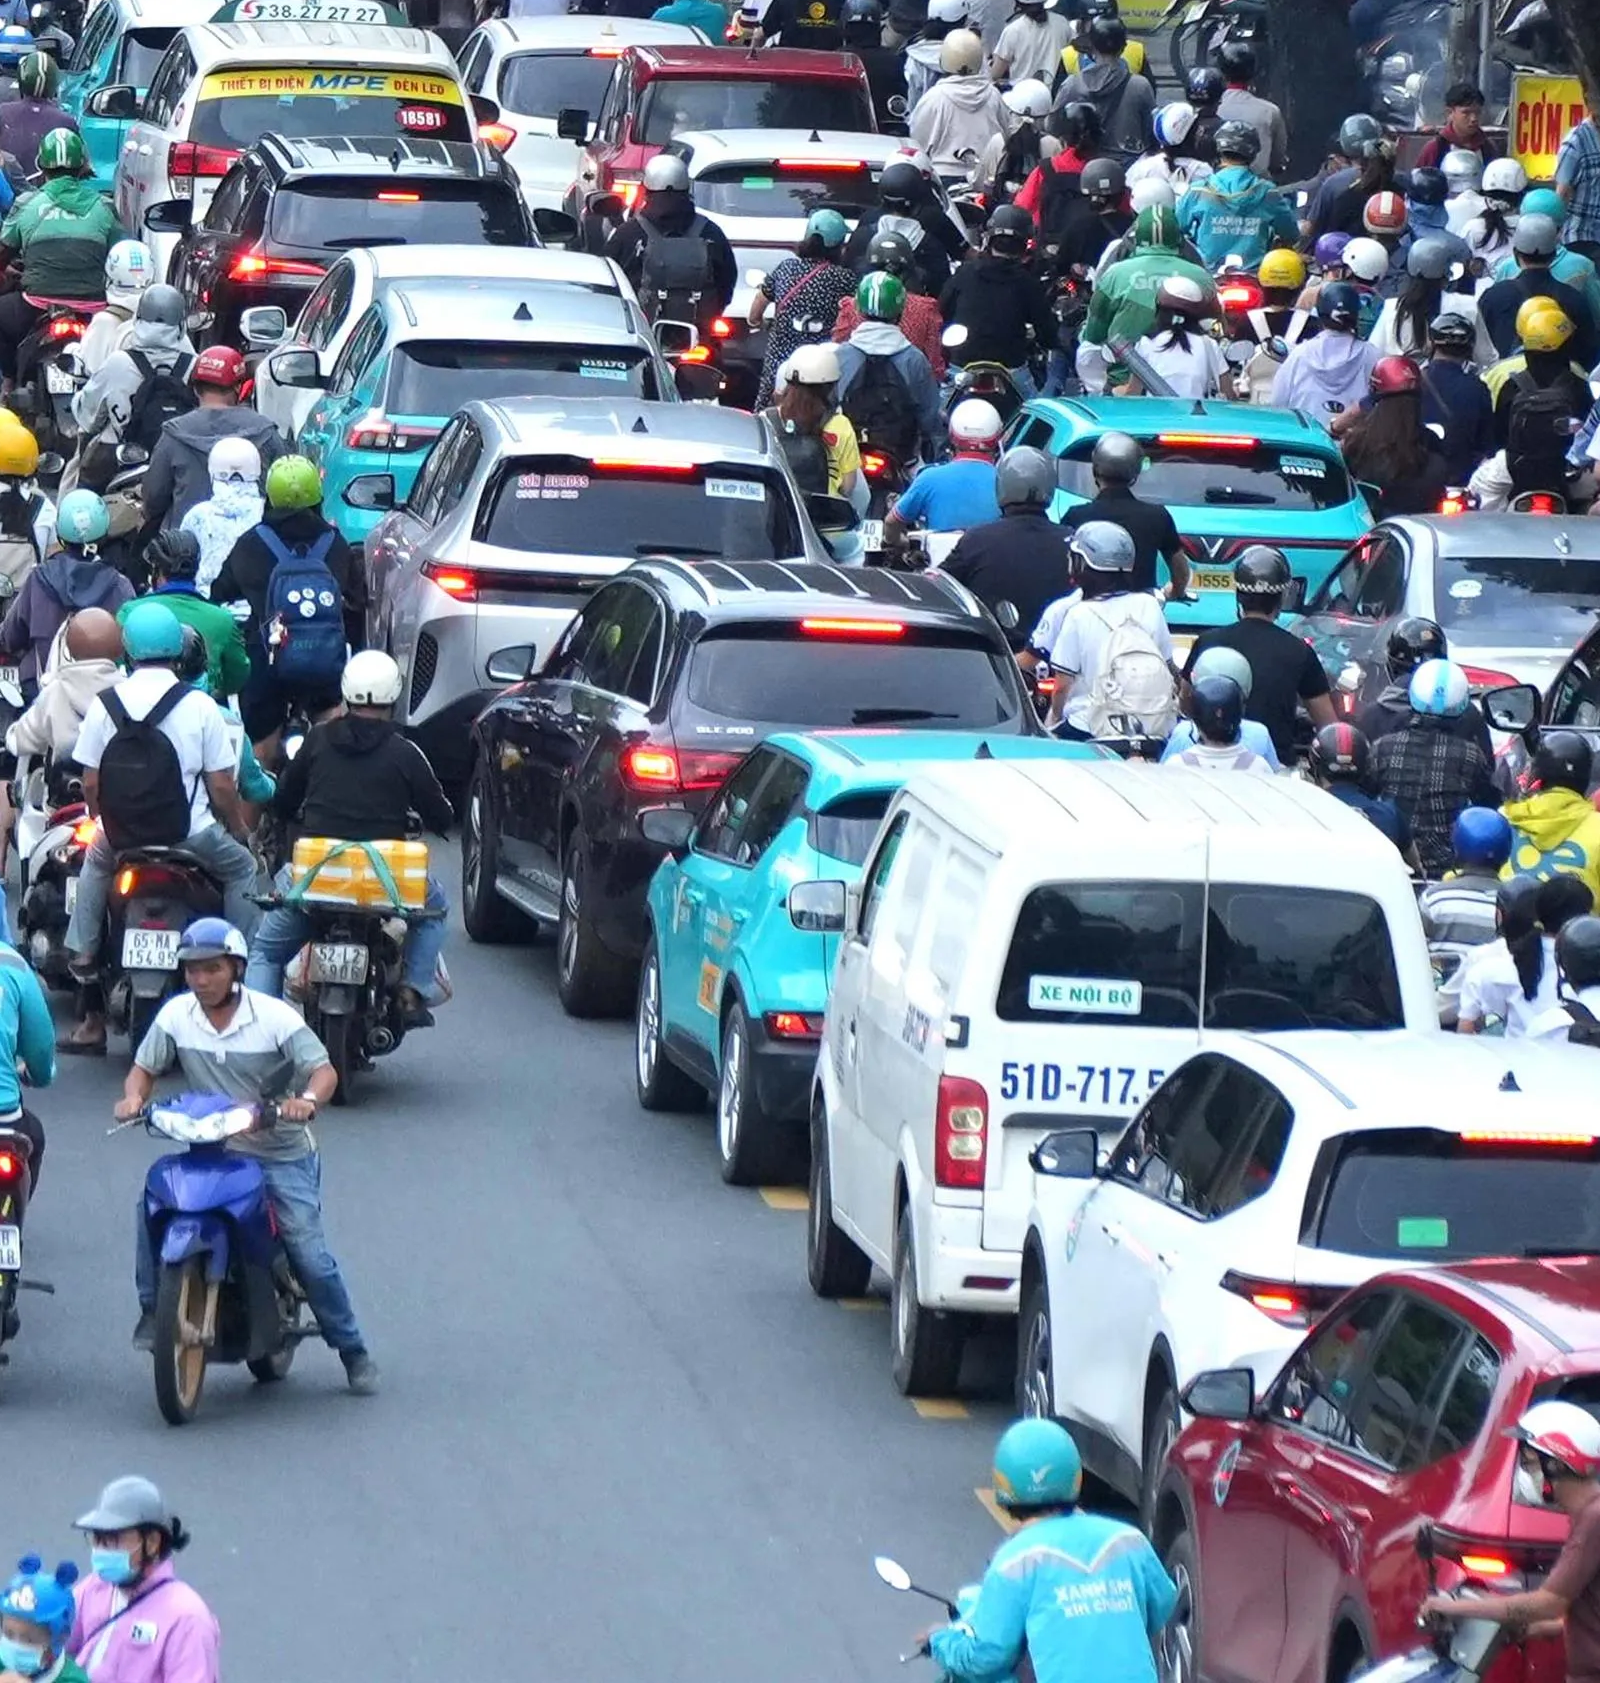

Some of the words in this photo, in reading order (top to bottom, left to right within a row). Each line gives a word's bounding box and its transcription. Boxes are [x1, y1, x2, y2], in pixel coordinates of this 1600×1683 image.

[268, 5, 321, 20] 38.27
[327, 7, 348, 21] 27
[356, 8, 379, 23] 27
[220, 77, 254, 91] THIẾT
[258, 78, 272, 92] BỊ
[309, 73, 390, 93] MPE
[421, 82, 446, 96] LED
[1516, 89, 1564, 156] CƠM
[1039, 985, 1064, 1001] XE
[1070, 985, 1102, 1004] NỘI
[1108, 988, 1134, 1008] BỘ
[1056, 1580, 1109, 1604] XANH
[1110, 1580, 1133, 1596] SM
[1063, 1599, 1090, 1620] xin
